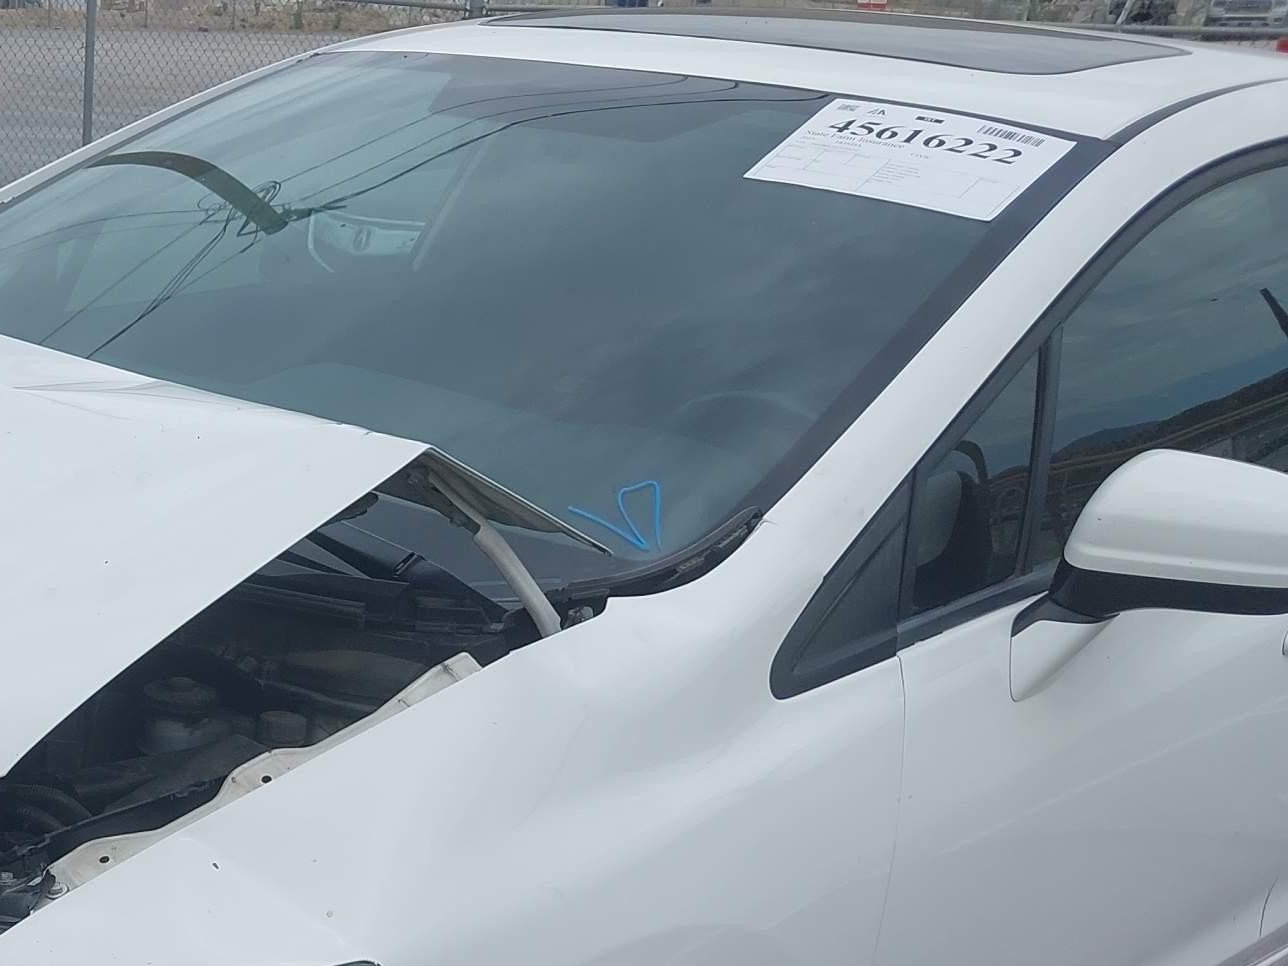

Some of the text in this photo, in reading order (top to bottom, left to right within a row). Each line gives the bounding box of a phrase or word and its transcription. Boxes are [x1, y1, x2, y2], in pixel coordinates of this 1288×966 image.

[806, 129, 830, 138] State
[830, 132, 857, 142] Farm
[857, 136, 906, 150] Insurance
[829, 118, 1024, 165] 45616222
